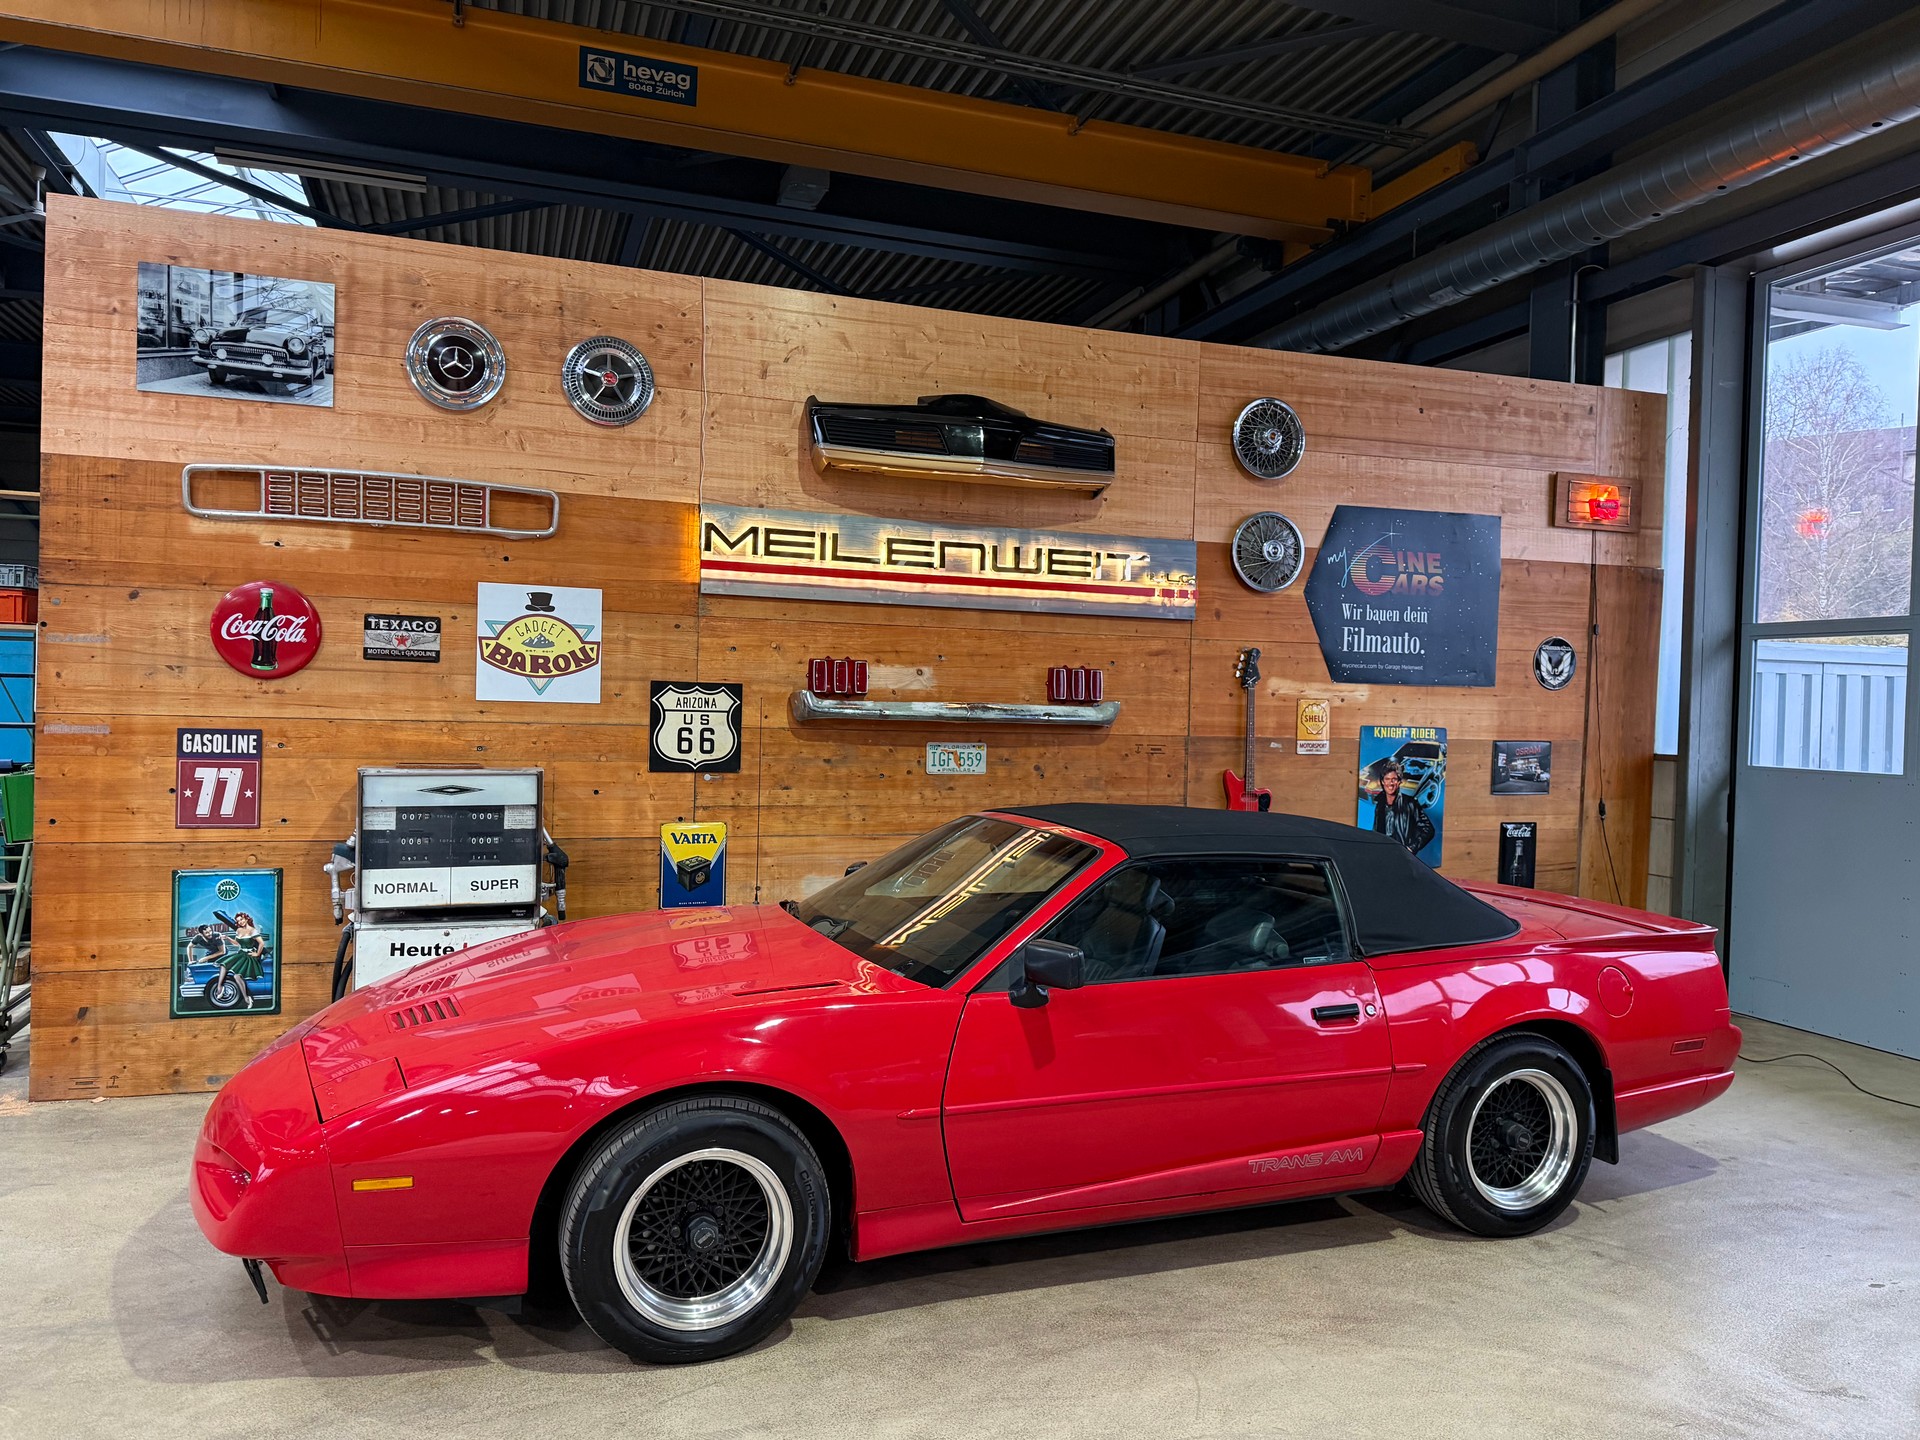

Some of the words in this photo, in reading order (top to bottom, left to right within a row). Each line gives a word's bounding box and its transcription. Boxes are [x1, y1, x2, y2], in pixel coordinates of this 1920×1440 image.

[623, 60, 691, 90] hevag
[628, 82, 653, 93] 8048
[655, 86, 685, 98] Zürich
[704, 522, 1151, 582] MEILENWEIT
[1342, 603, 1363, 621] Wir
[1366, 604, 1400, 623] bauen
[1403, 606, 1428, 624] dein
[221, 612, 309, 643] Coca-Cola
[367, 617, 437, 632] TEXACO
[514, 620, 566, 639] GADGET
[1342, 627, 1425, 655] Filmauto.
[486, 641, 595, 674] BARON
[1378, 661, 1384, 670] by
[1384, 663, 1401, 671] Garage
[675, 696, 718, 709] ARIZONA
[1304, 714, 1325, 723] SHELL
[677, 726, 716, 755] 66
[1374, 726, 1408, 738] KNIGHT
[182, 733, 258, 754] GASOLINE
[1515, 745, 1541, 756] OSRAM
[194, 767, 244, 818] 77
[670, 832, 718, 845] VARTA
[1506, 826, 1532, 838] Coca-Cola
[374, 882, 438, 895] NORMAL
[470, 878, 519, 892] SUPER
[390, 942, 455, 957] Heute
[1248, 1152, 1324, 1174] TRANS
[1324, 1147, 1363, 1165] AM
